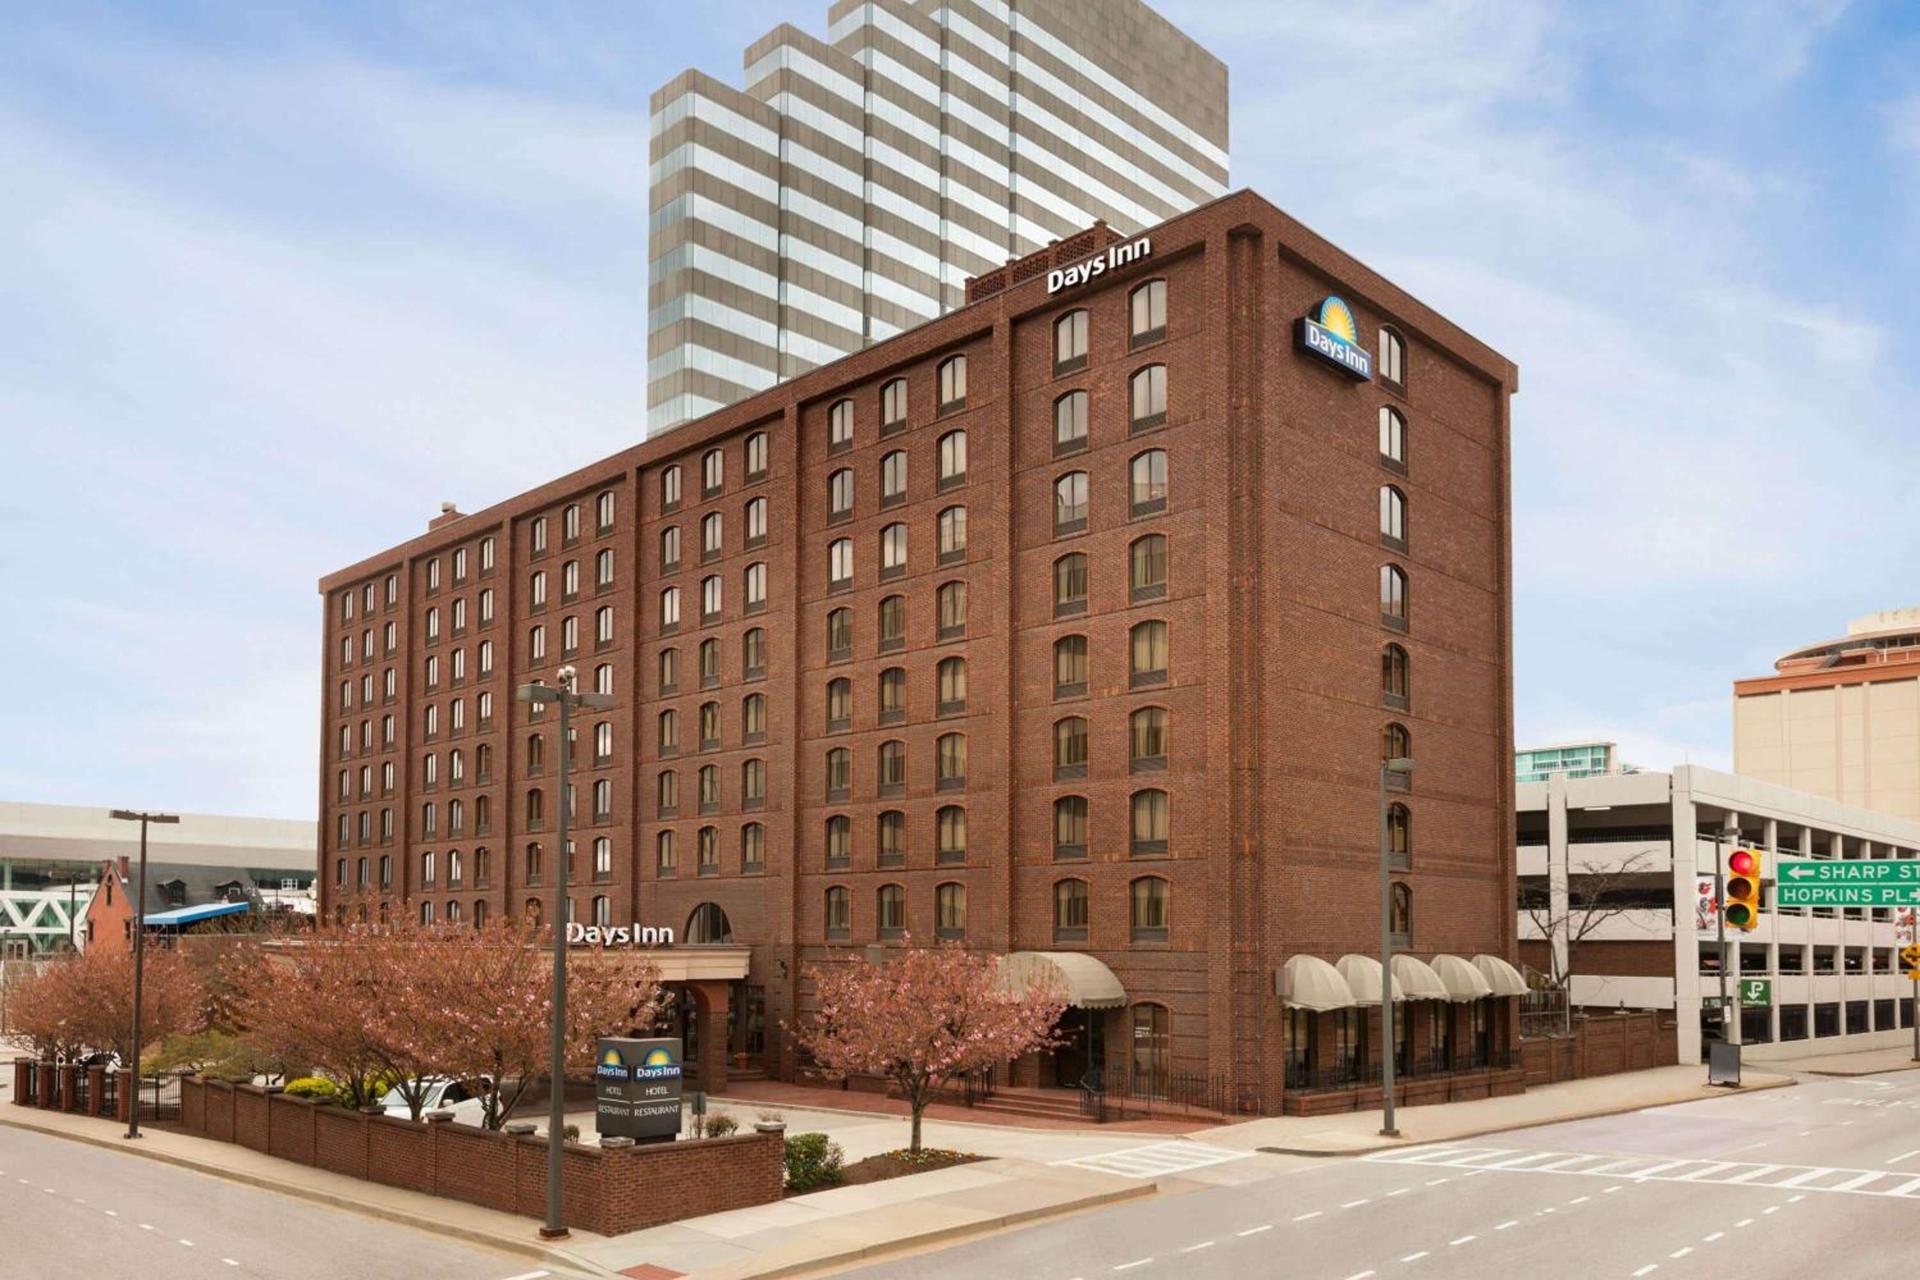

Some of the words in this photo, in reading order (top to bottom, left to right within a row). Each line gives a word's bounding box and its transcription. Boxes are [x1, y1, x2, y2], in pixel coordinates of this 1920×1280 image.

[1047, 255, 1106, 294] Days
[1109, 237, 1151, 269] Inn
[1309, 324, 1344, 360] Days
[1345, 344, 1368, 374] Inn
[1818, 865, 1890, 879] SHARP
[1899, 864, 1920, 879] ST
[1783, 888, 1873, 902] HOPKINS
[566, 922, 630, 946] Days
[633, 922, 675, 943] Inn
[636, 1067, 663, 1078] Days
[663, 1066, 681, 1076] Inn
[645, 1086, 670, 1096] HOTEL
[634, 1105, 679, 1117] RESTAURANT
